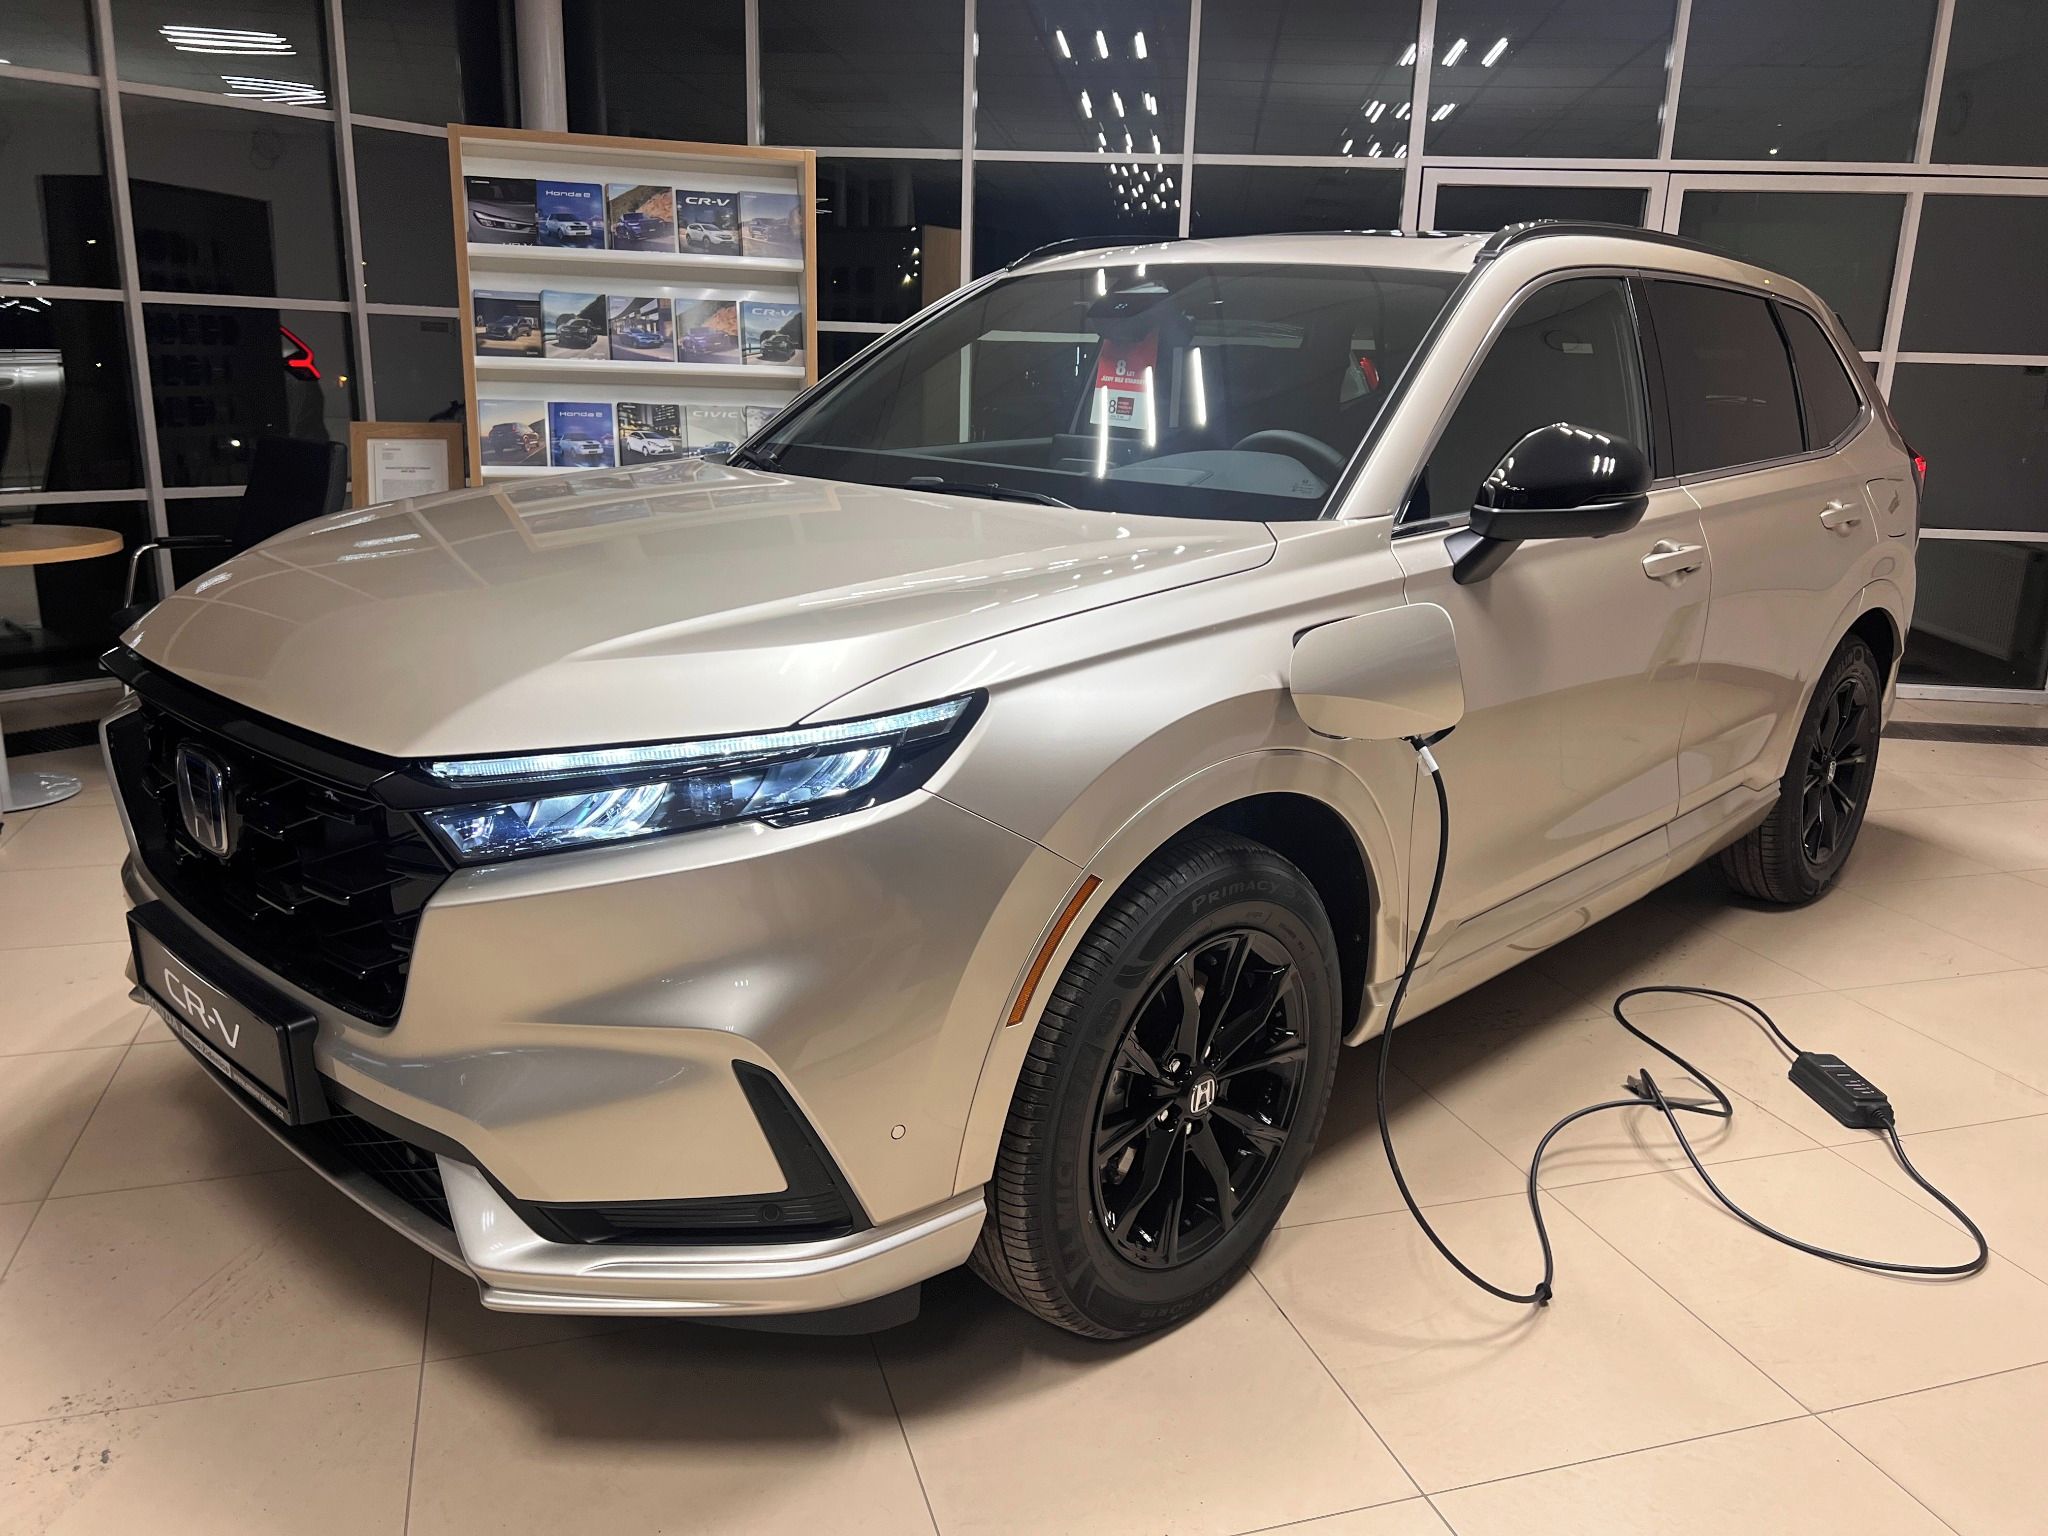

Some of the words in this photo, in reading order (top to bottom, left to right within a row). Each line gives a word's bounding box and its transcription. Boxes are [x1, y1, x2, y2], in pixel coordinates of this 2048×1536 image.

[545, 189, 582, 198] Honda
[685, 195, 731, 207] CR-V
[751, 306, 793, 317] CR-V
[1116, 360, 1126, 376] 8
[1108, 399, 1116, 414] 8
[559, 410, 593, 418] Honda
[692, 409, 739, 419] CIVIC
[1191, 879, 1280, 914] PRIMACY
[163, 967, 240, 1050] CR-V
